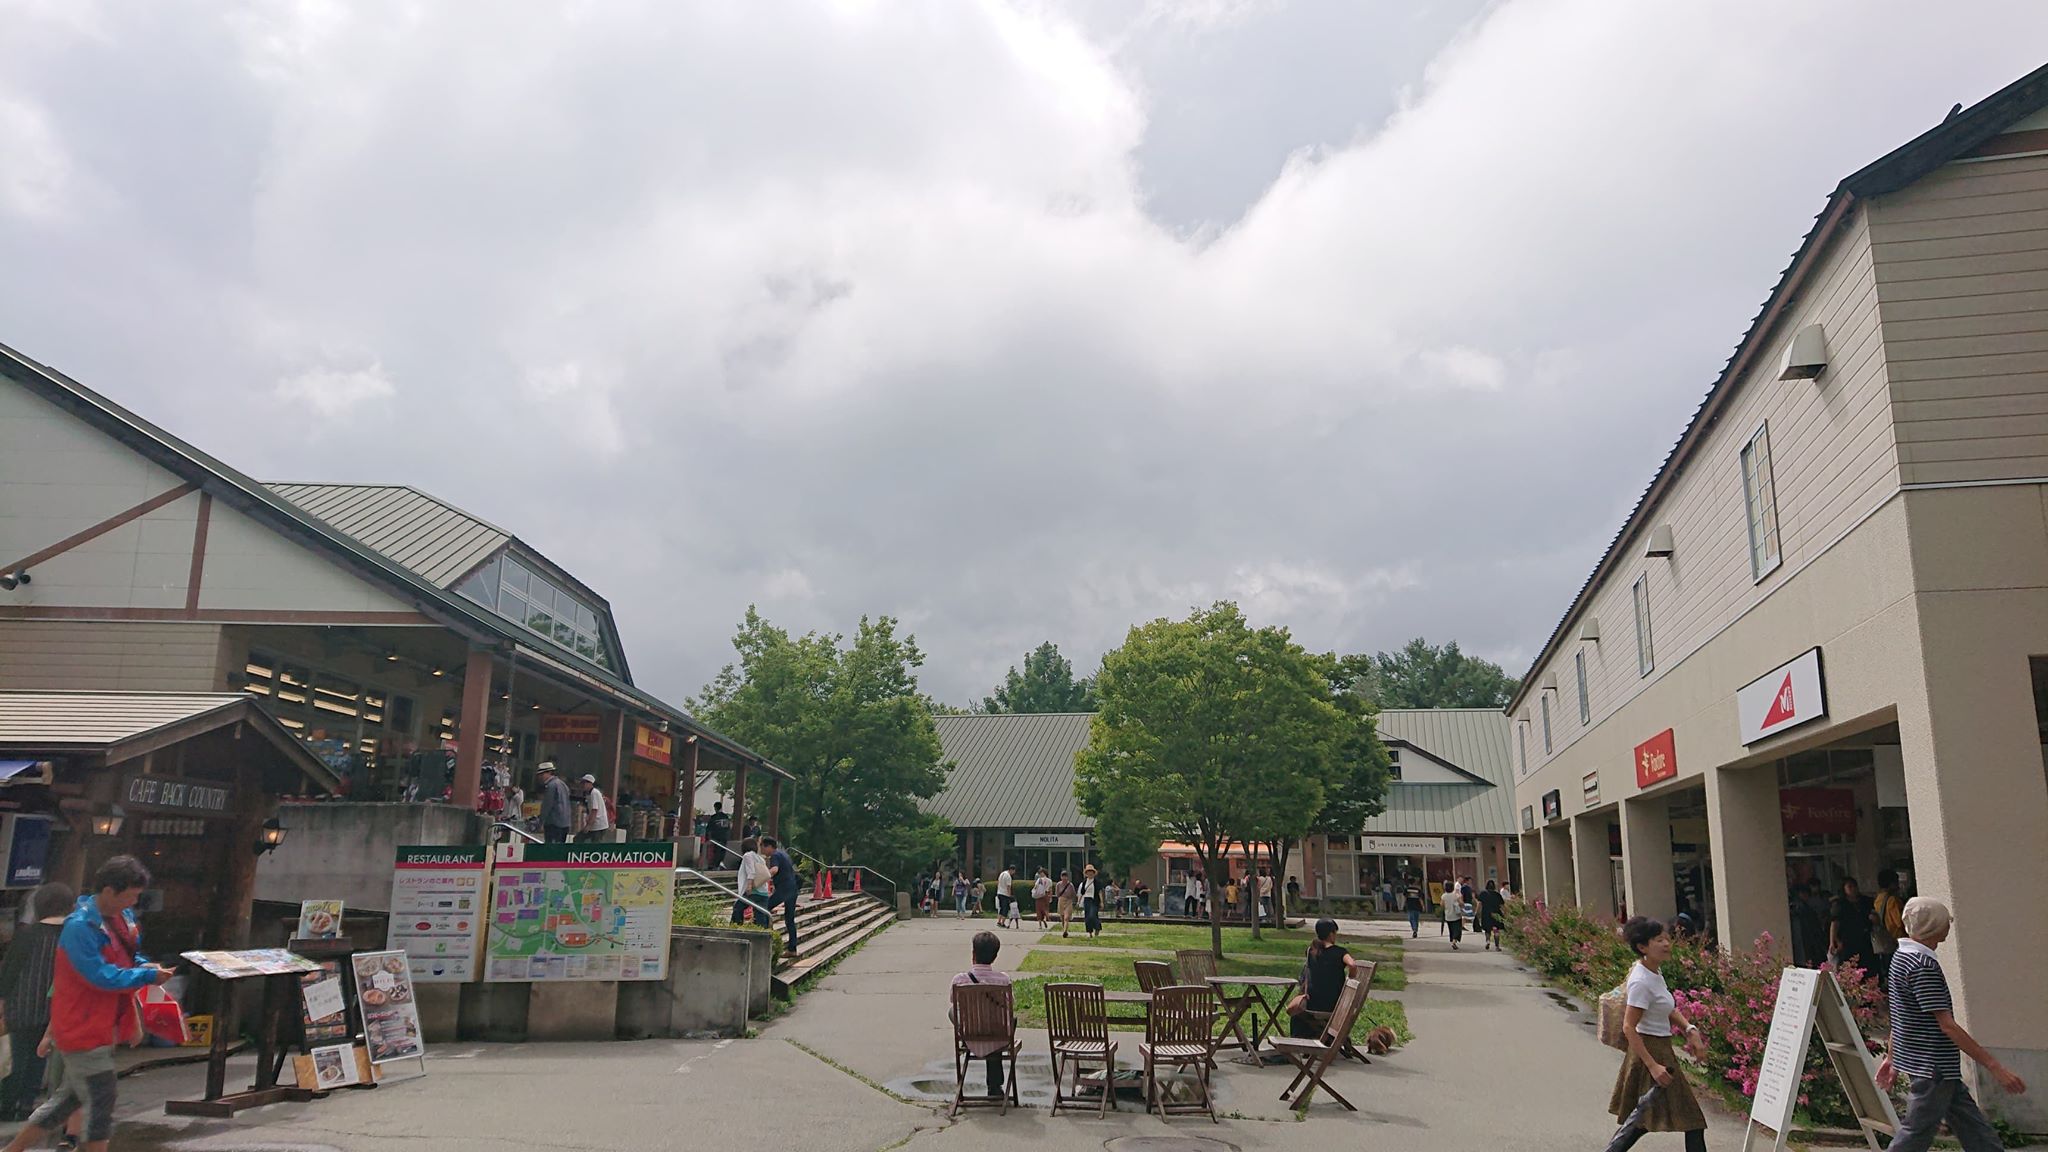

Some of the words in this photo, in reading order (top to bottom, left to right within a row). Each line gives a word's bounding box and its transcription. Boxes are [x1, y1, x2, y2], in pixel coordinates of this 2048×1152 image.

[129, 778, 157, 803] CAFE
[160, 782, 186, 806] BACK
[189, 786, 228, 810] COUNTRY
[407, 854, 475, 864] RESTAURANT
[567, 851, 666, 864] INFORMATION
